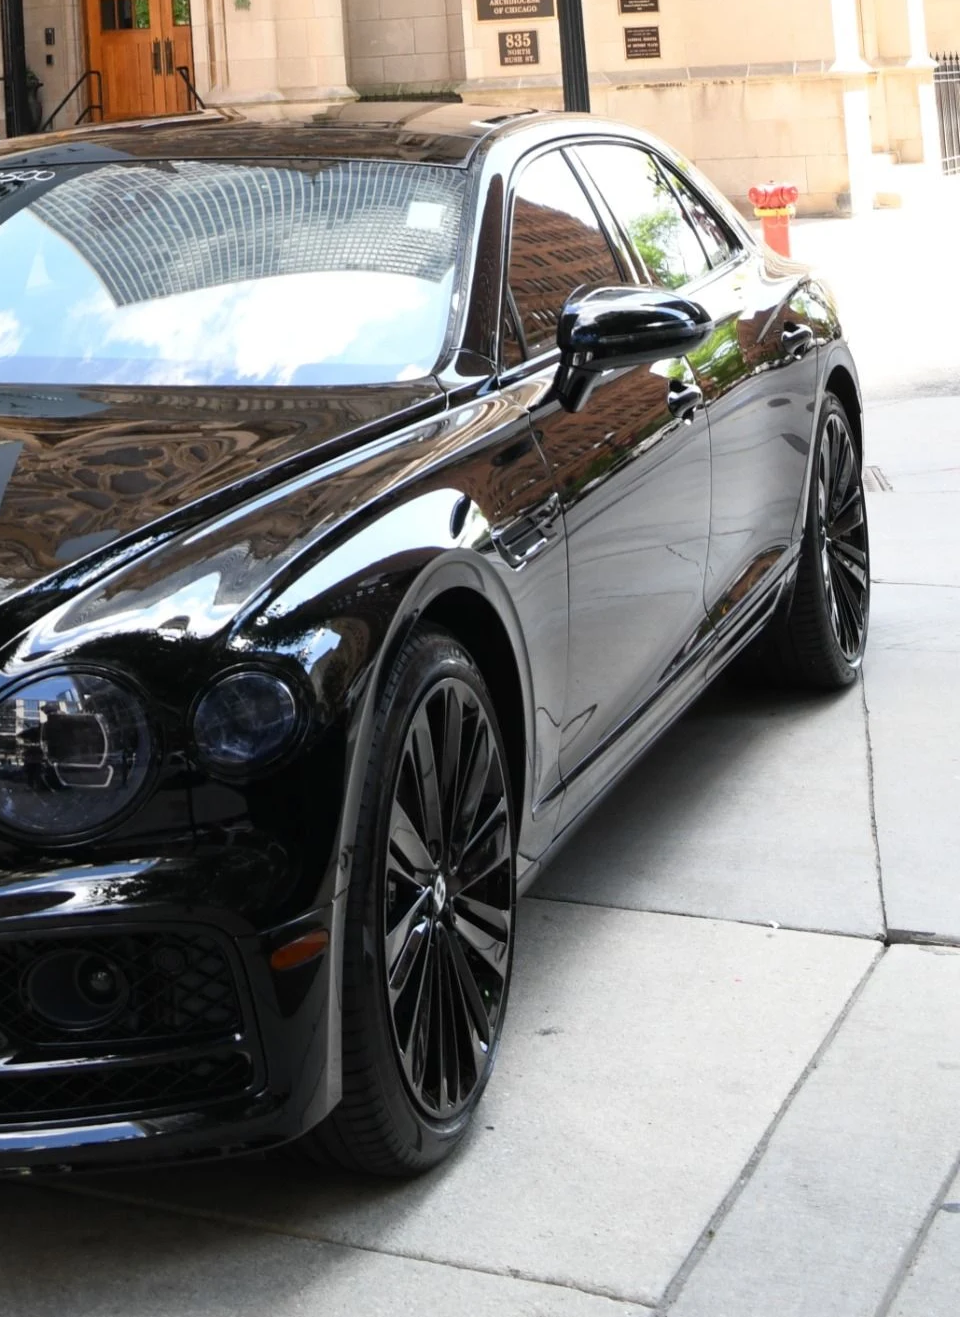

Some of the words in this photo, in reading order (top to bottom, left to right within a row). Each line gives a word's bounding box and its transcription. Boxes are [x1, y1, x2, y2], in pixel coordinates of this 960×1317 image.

[493, 7, 503, 15] OF
[504, 5, 538, 14] CHICAGO
[505, 32, 531, 48] 835
